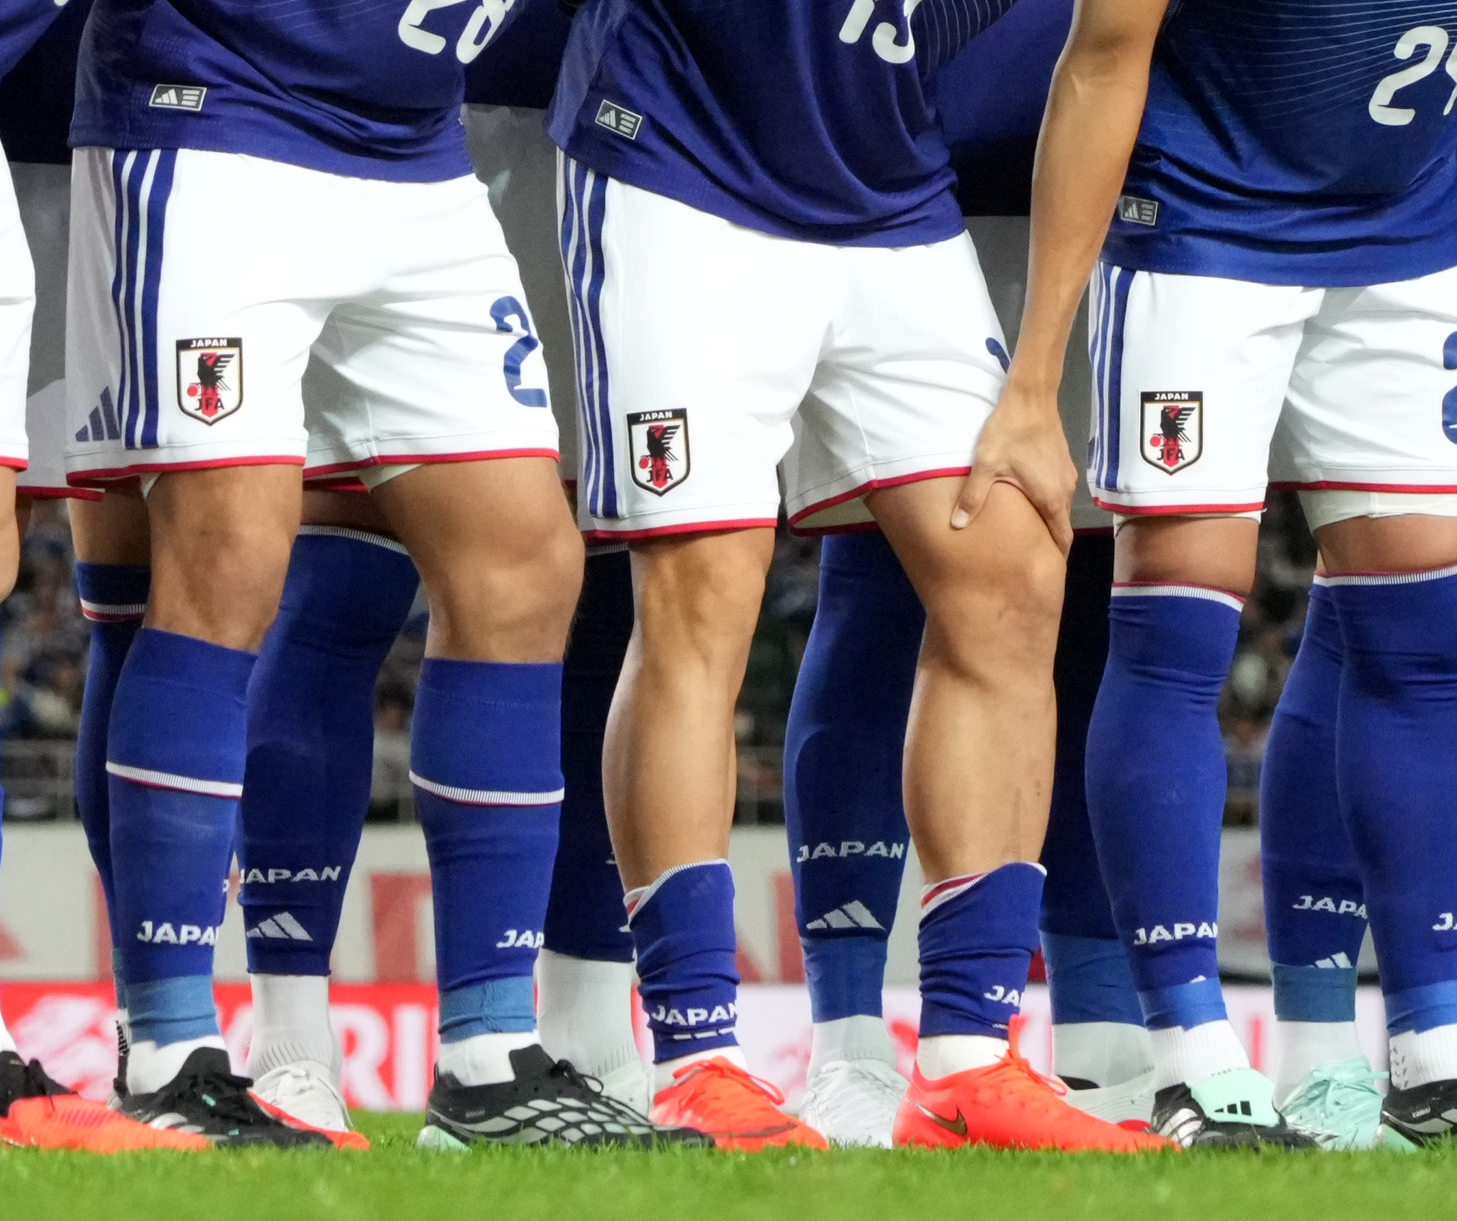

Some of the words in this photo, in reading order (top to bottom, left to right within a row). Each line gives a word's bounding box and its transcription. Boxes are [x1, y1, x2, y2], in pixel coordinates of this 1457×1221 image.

[190, 338, 227, 348] JAPAN
[1154, 392, 1188, 401] JAPAN
[194, 398, 224, 411] JFA
[639, 411, 673, 421] JAPAN
[1156, 449, 1185, 461] JFA
[646, 469, 674, 483] JFA
[796, 841, 904, 863] JAPAN
[1292, 895, 1368, 919] JAPA
[137, 920, 220, 946] JAPA
[496, 929, 545, 949] JAP
